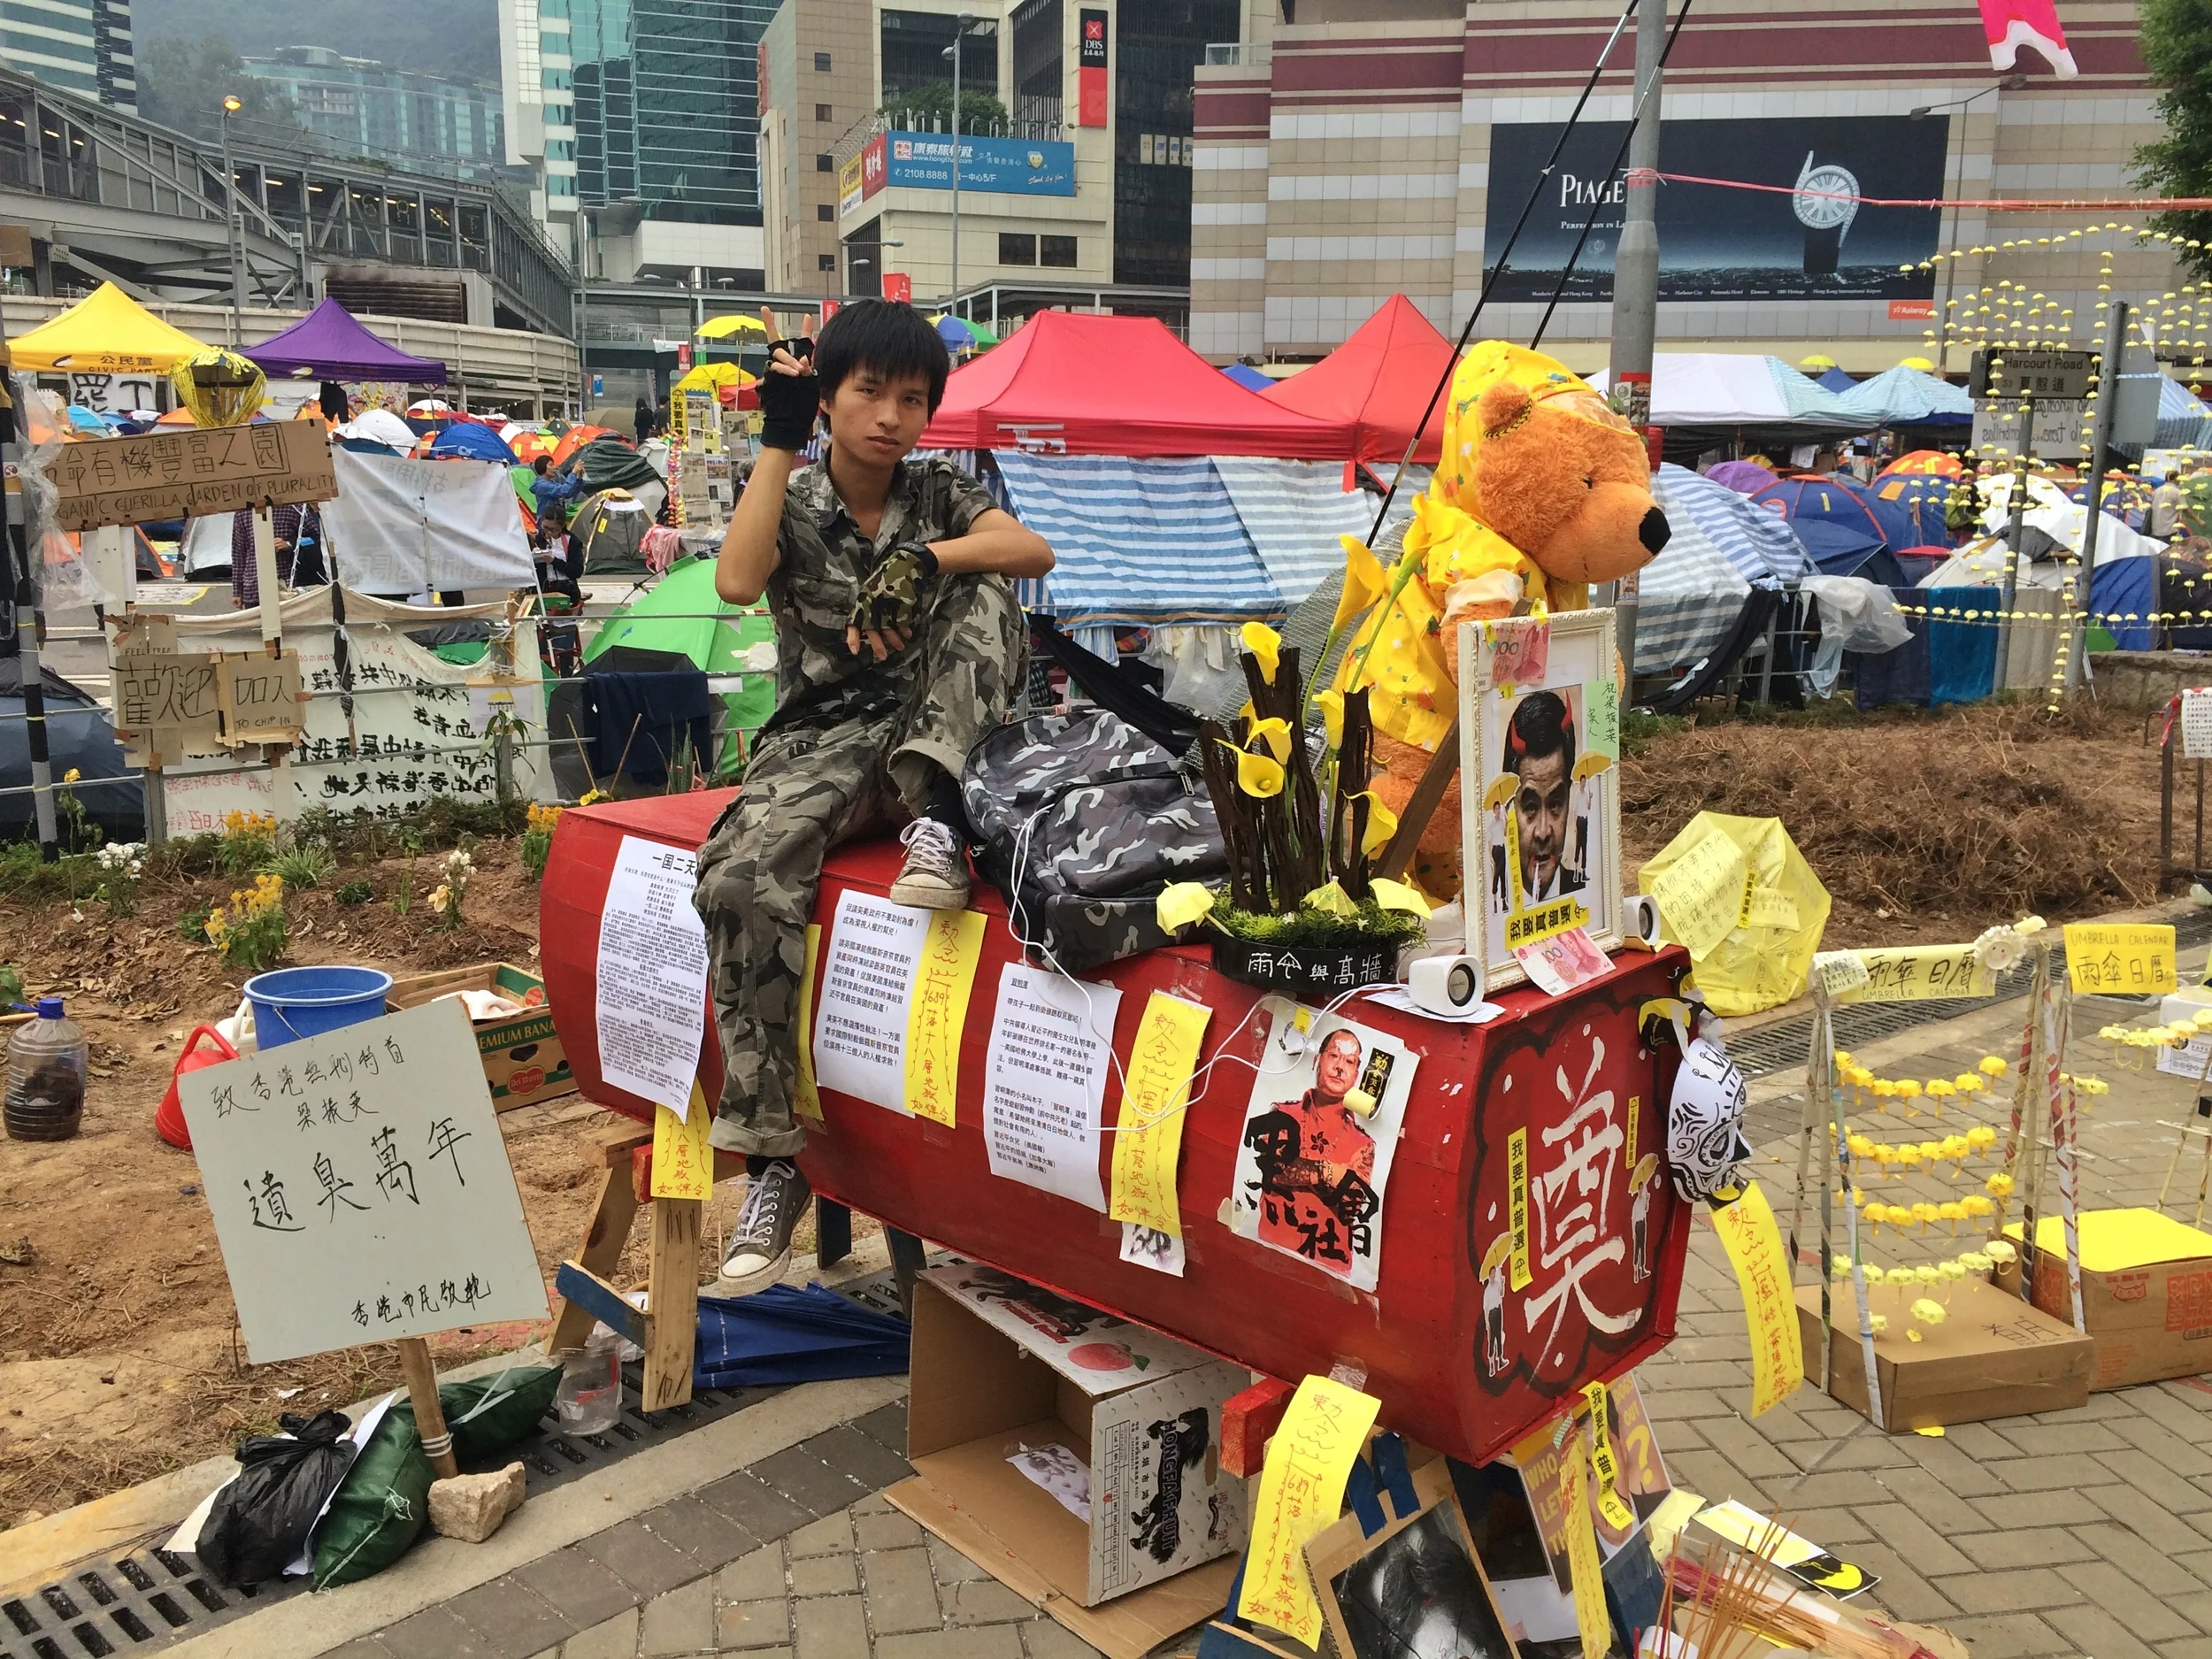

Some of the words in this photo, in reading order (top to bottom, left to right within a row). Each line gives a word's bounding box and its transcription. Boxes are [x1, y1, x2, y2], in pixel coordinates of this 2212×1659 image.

[1085, 40, 1103, 49] DBS
[904, 168, 926, 179] 2108
[926, 170, 948, 180] 8888
[912, 156, 973, 165] www.hongthacom
[100, 356, 153, 366] 公民黨
[2003, 357, 2052, 370] Harcourt
[2056, 357, 2083, 370] Road
[58, 495, 108, 519] GANIC
[114, 491, 181, 513] GUERILLA
[186, 483, 242, 505] GARDEN
[245, 480, 264, 498] OF
[267, 474, 335, 495] PLURALITY
[125, 647, 146, 657] FEEL
[109, 662, 216, 725] 歡迎
[234, 676, 295, 706] 加入
[236, 718, 249, 728] TO
[254, 716, 274, 726] CHIP
[280, 716, 291, 726] IN
[1509, 902, 1571, 942] 我要真普選
[2071, 931, 2120, 946] UMBRELLA
[2129, 933, 2170, 947] CALENDAR
[1541, 947, 1563, 964] 100
[1862, 987, 1915, 999] UMBRELLA
[1929, 986, 1972, 997] CALENDAR
[479, 1027, 522, 1050] EMIUM
[524, 1019, 557, 1039] BANA
[511, 1078, 522, 1087] Del
[521, 1072, 543, 1083] Monte
[296, 1091, 380, 1133] 梁振英
[243, 1117, 473, 1232] 遺臭萬年
[1511, 1139, 1527, 1254] 我要真普選
[1612, 1376, 1635, 1407] DOGS
[1625, 1424, 1653, 1486] ?
[1525, 1453, 1558, 1492] WHO
[1162, 1495, 1178, 1550] FRUIT
[1549, 1526, 1569, 1555] TH
